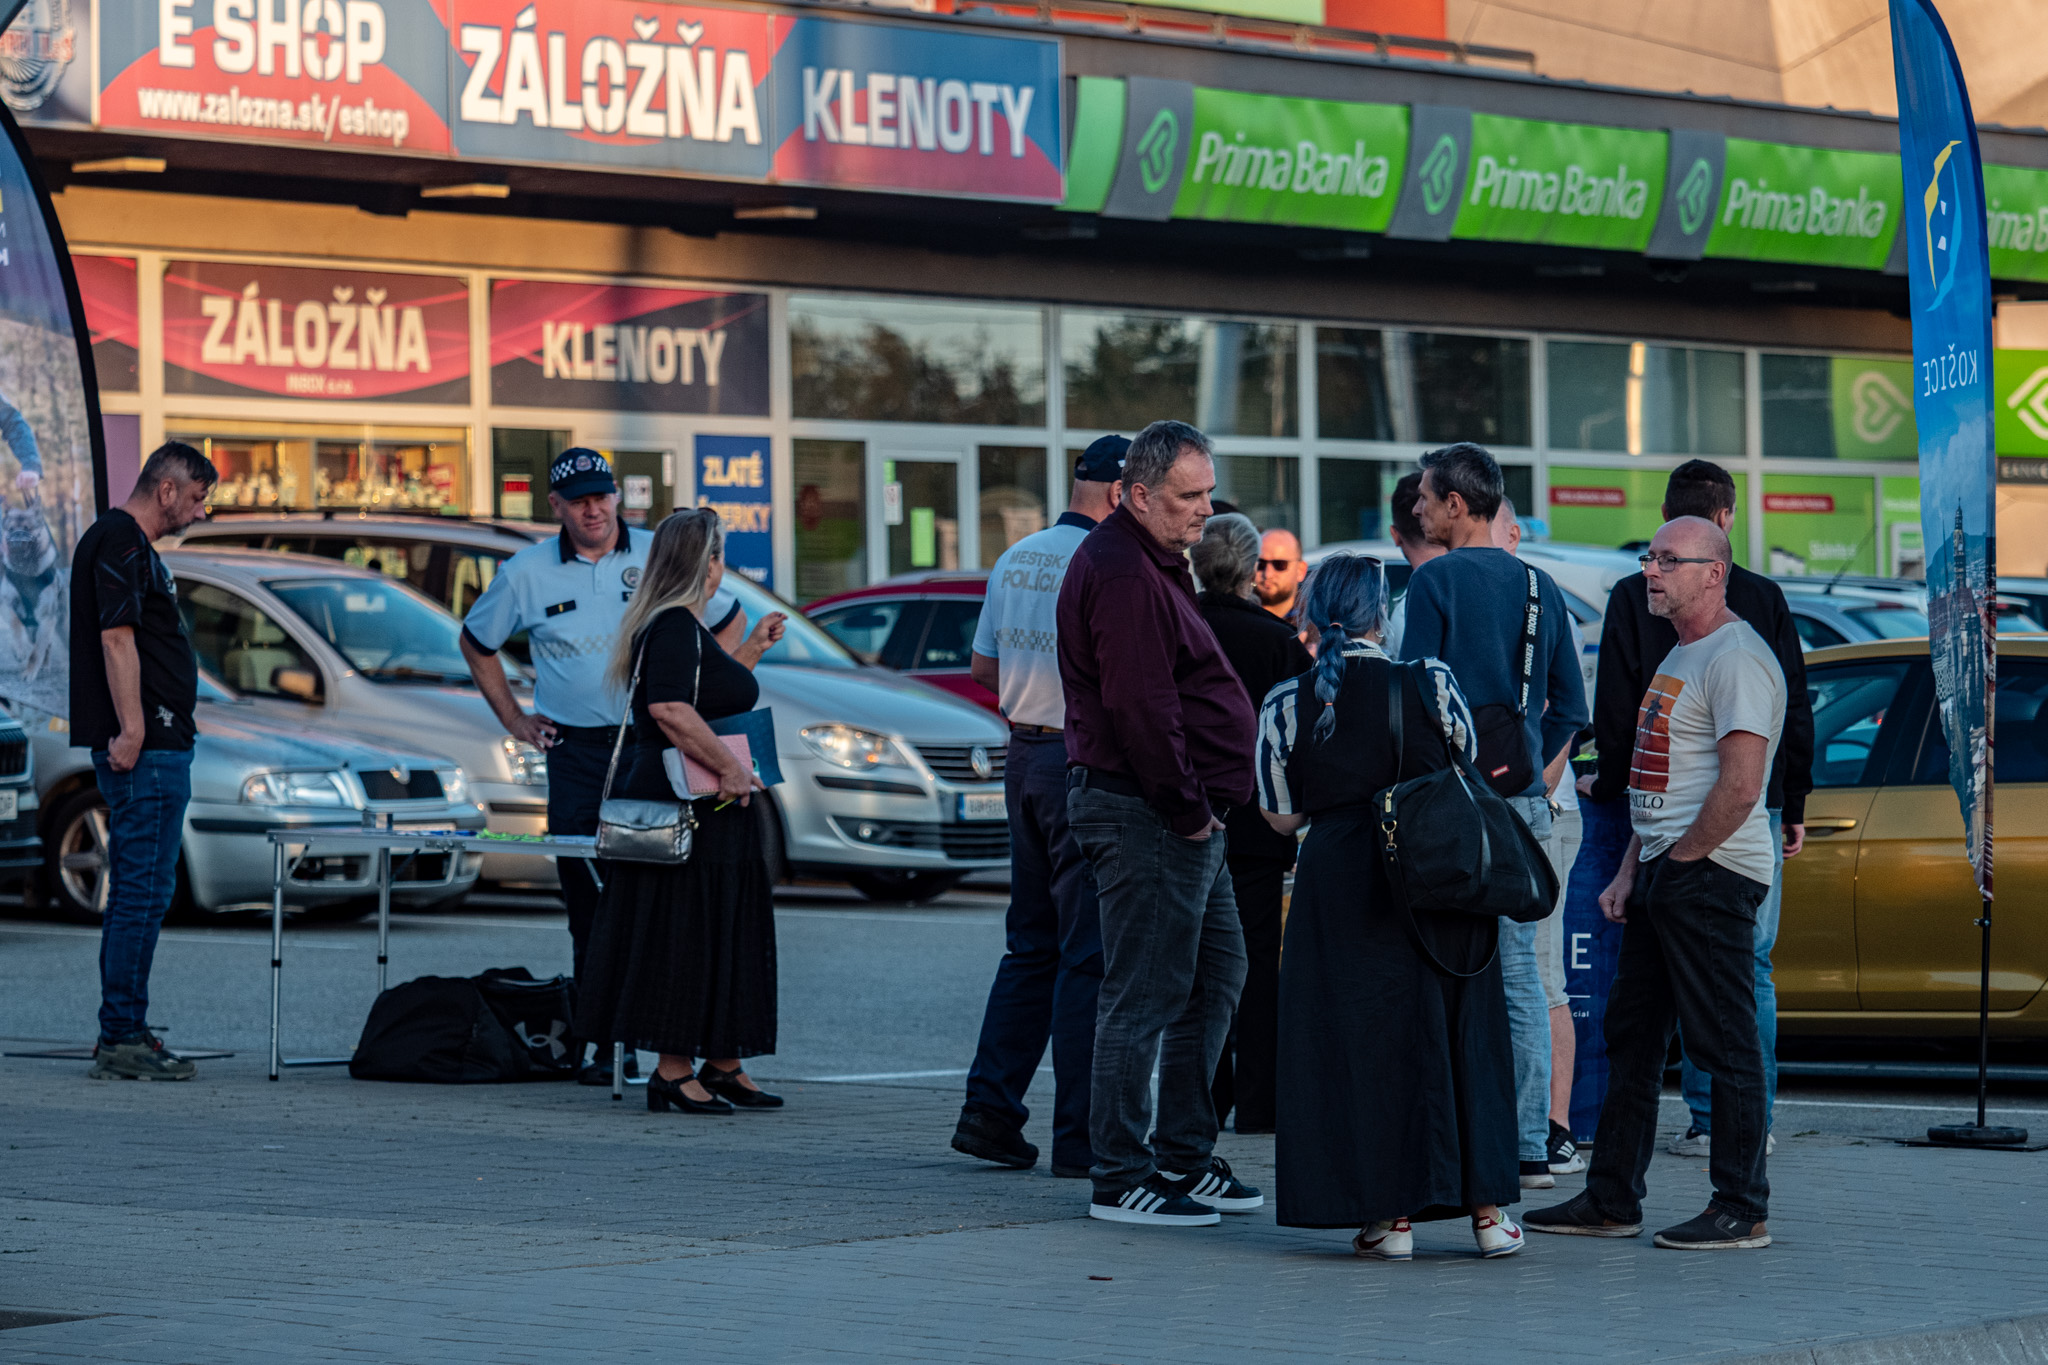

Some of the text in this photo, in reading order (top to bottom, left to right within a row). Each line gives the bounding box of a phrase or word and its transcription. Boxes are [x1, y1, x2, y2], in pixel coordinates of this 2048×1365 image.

[158, 0, 196, 68] E
[212, 0, 386, 84] SHOP
[460, 4, 763, 146] ZÁLOŽŇA
[137, 86, 410, 148] www.zalozna.sk/eshop
[803, 67, 1035, 158] KLENOTY
[201, 280, 431, 373] ZÁLOŽŇA
[542, 320, 728, 387] KLENOTY
[702, 450, 764, 488] ZLATÉ
[1524, 642, 1535, 676] SERIOUS
[1571, 933, 1592, 969] E
[1572, 1010, 1590, 1018] cial
